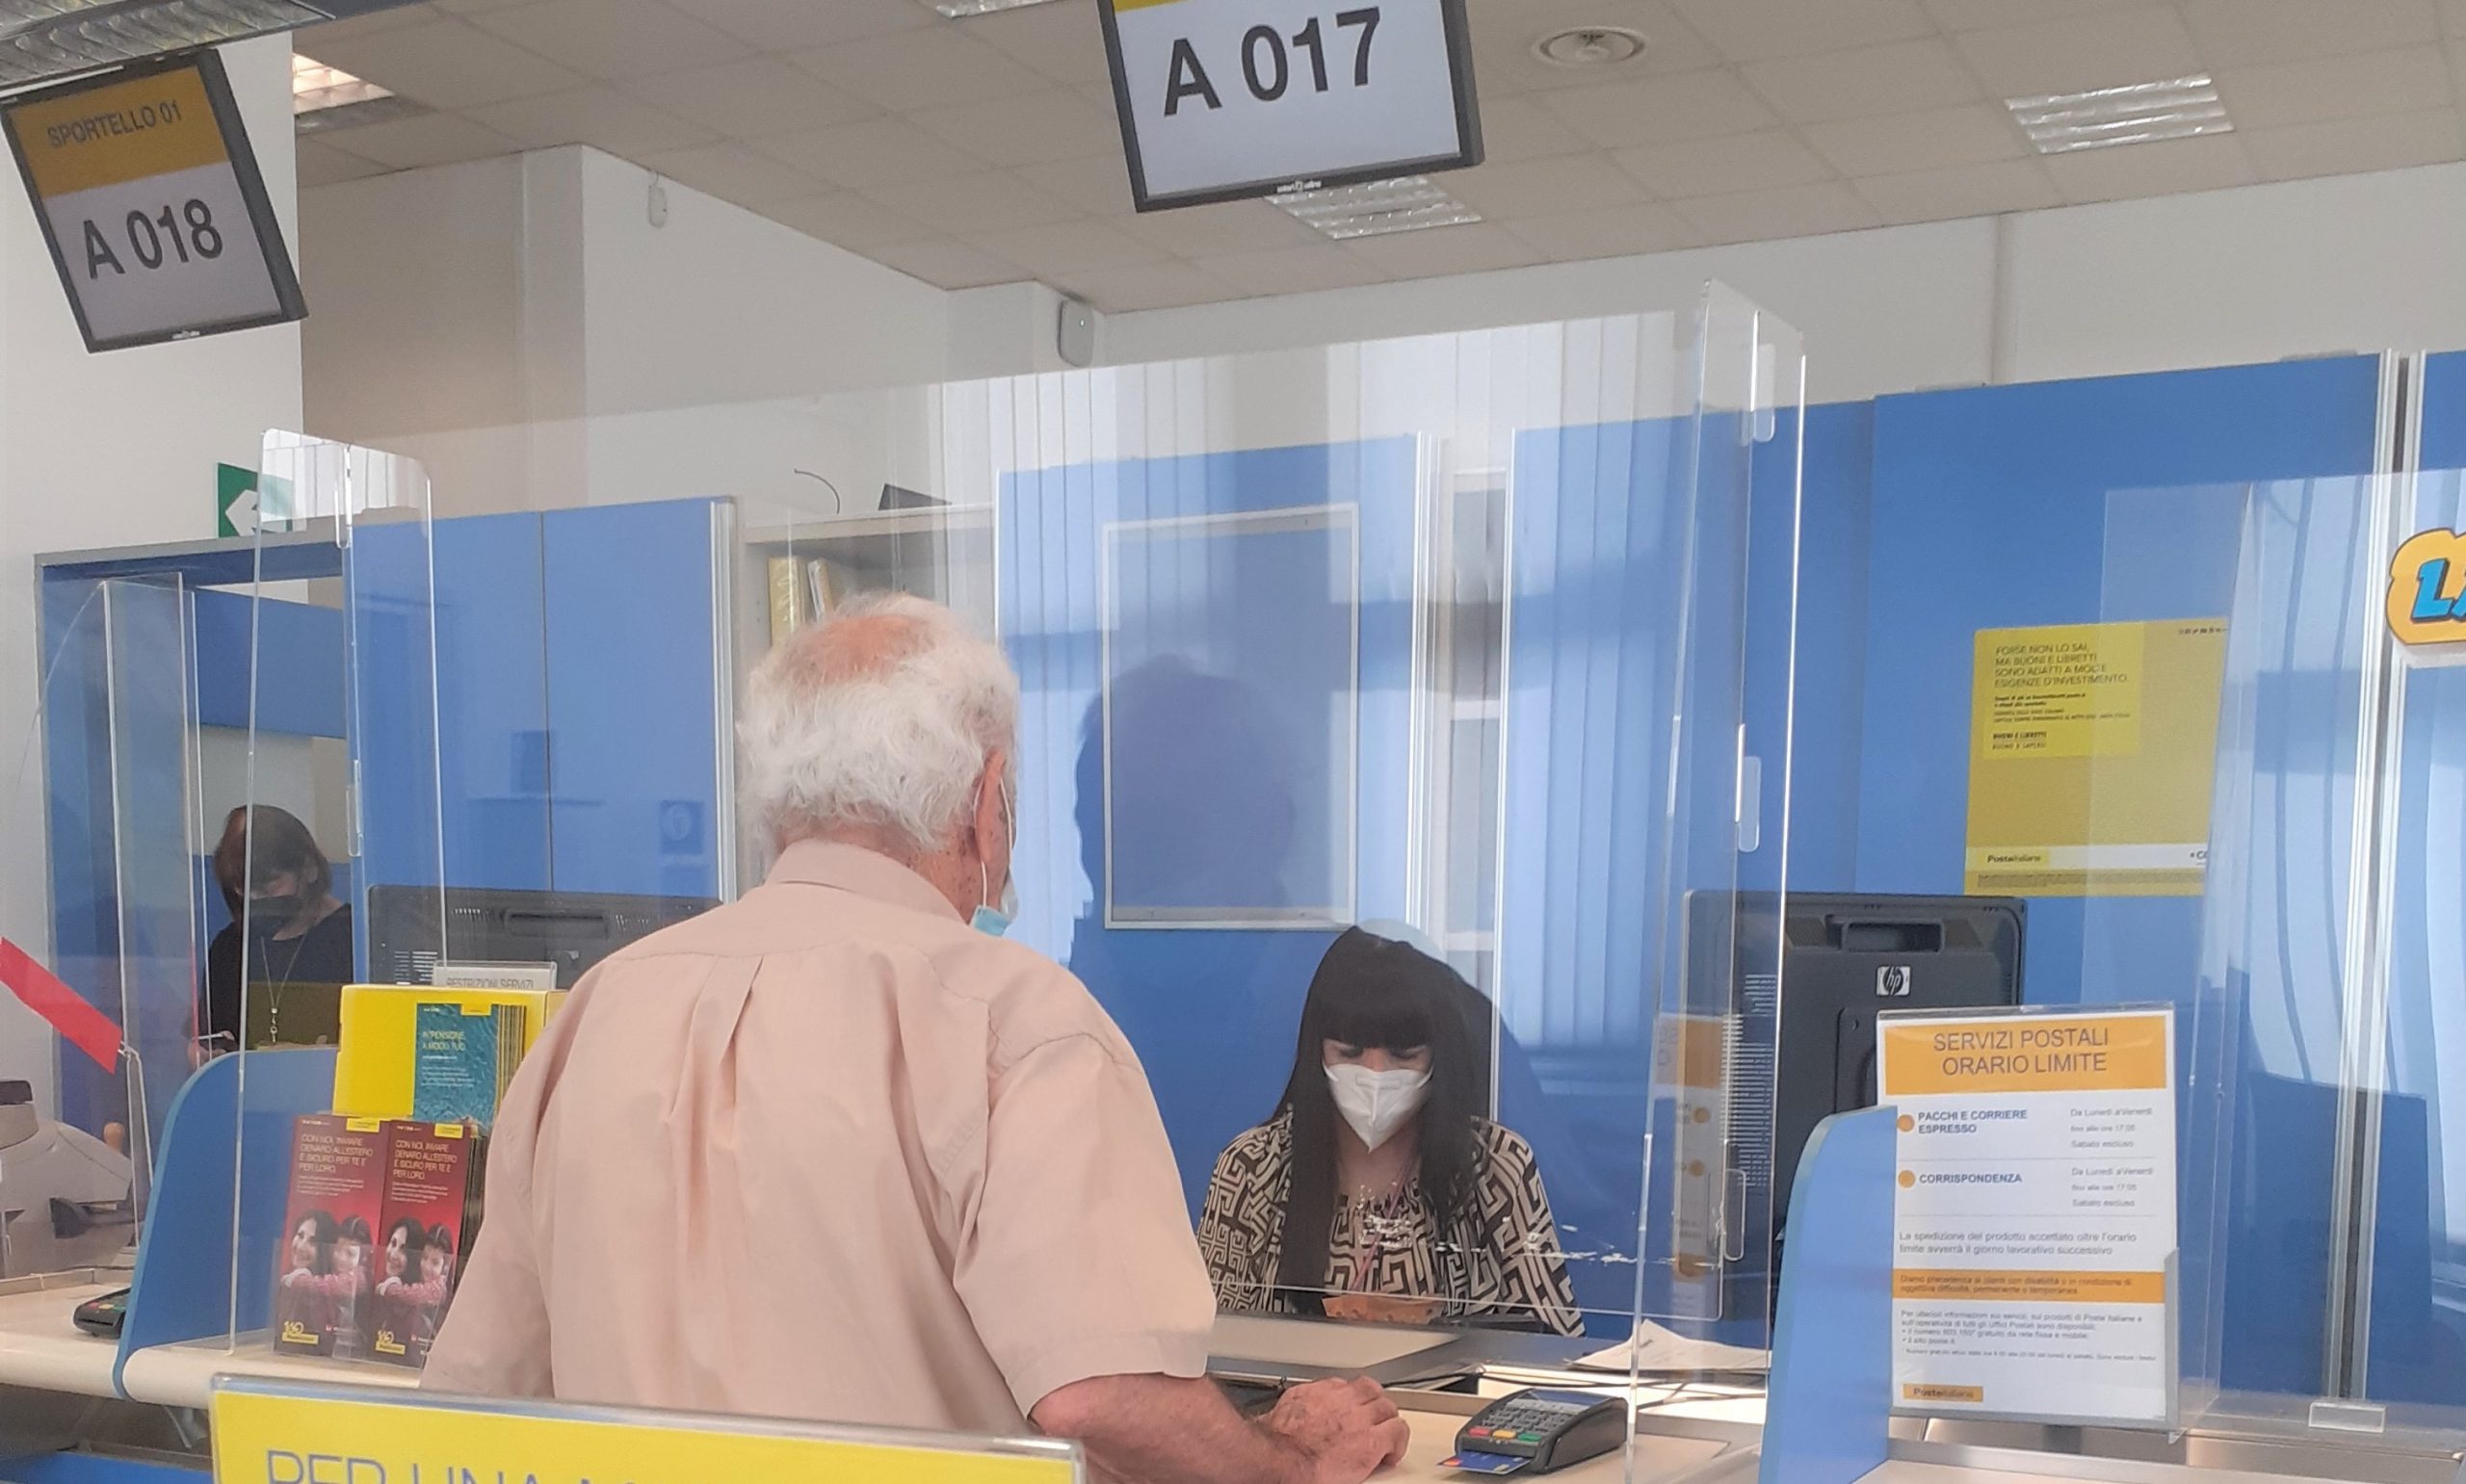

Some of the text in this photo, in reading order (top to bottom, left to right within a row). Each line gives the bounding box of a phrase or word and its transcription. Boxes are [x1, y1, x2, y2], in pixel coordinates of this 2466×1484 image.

[1164, 6, 1380, 117] A 017
[47, 100, 181, 147] SPORTELLO 01
[83, 198, 223, 279] A 018
[2029, 644, 2053, 653] NON
[2056, 643, 2070, 653] LO
[1996, 657, 2011, 666] MA
[2013, 656, 2043, 665] BUONI
[2057, 653, 2097, 664] LIBRETTI
[1995, 667, 2025, 678] SONO
[2064, 664, 2072, 673] A
[1933, 1028, 2109, 1051] SERVIZI POSTALI
[1942, 1053, 2107, 1076] ORARIO LIMITE
[1918, 1109, 2028, 1121] PACCHI E CORRIERE
[1918, 1124, 1977, 1134] ESPRESSO
[1919, 1173, 2022, 1184] CORRISPONDENZA
[1914, 1232, 1964, 1242] spedizione
[1985, 1233, 2026, 1242] prodotto
[2028, 1233, 2074, 1241] accettato
[2077, 1233, 2099, 1241] oltre
[1899, 1244, 1925, 1253] limite
[1973, 1246, 2004, 1255] giorno
[2007, 1245, 2055, 1255] lavorativo
[2057, 1246, 2112, 1255] successivo
